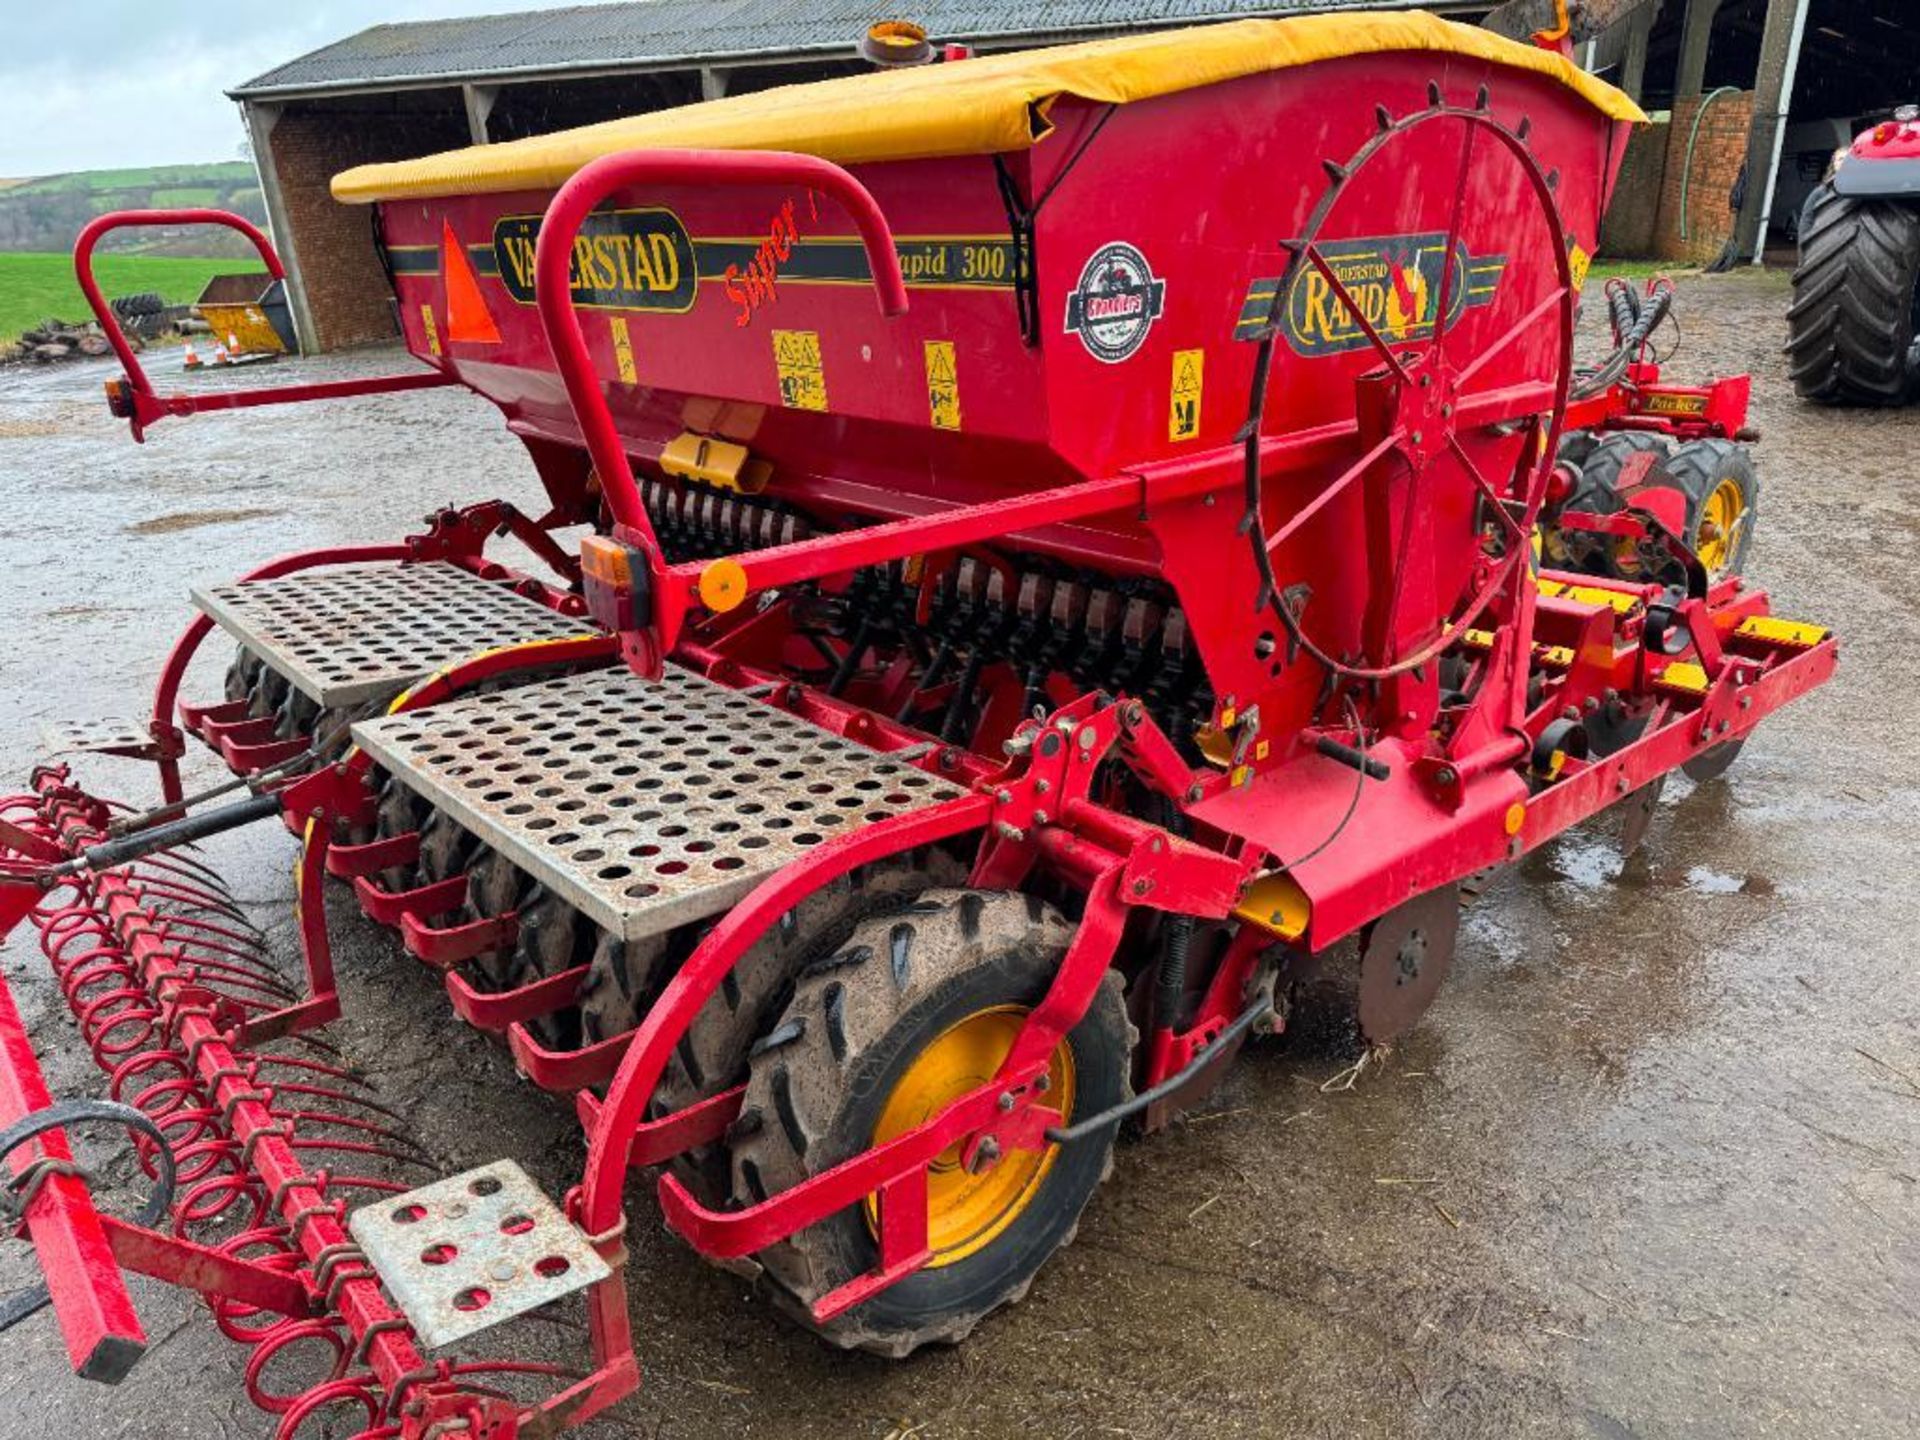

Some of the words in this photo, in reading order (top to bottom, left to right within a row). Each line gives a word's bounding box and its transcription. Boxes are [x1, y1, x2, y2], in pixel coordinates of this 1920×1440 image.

[725, 198, 799, 327] Super
[897, 245, 948, 279] apid
[961, 246, 1005, 278] 300
[1302, 270, 1385, 341] RAPID
